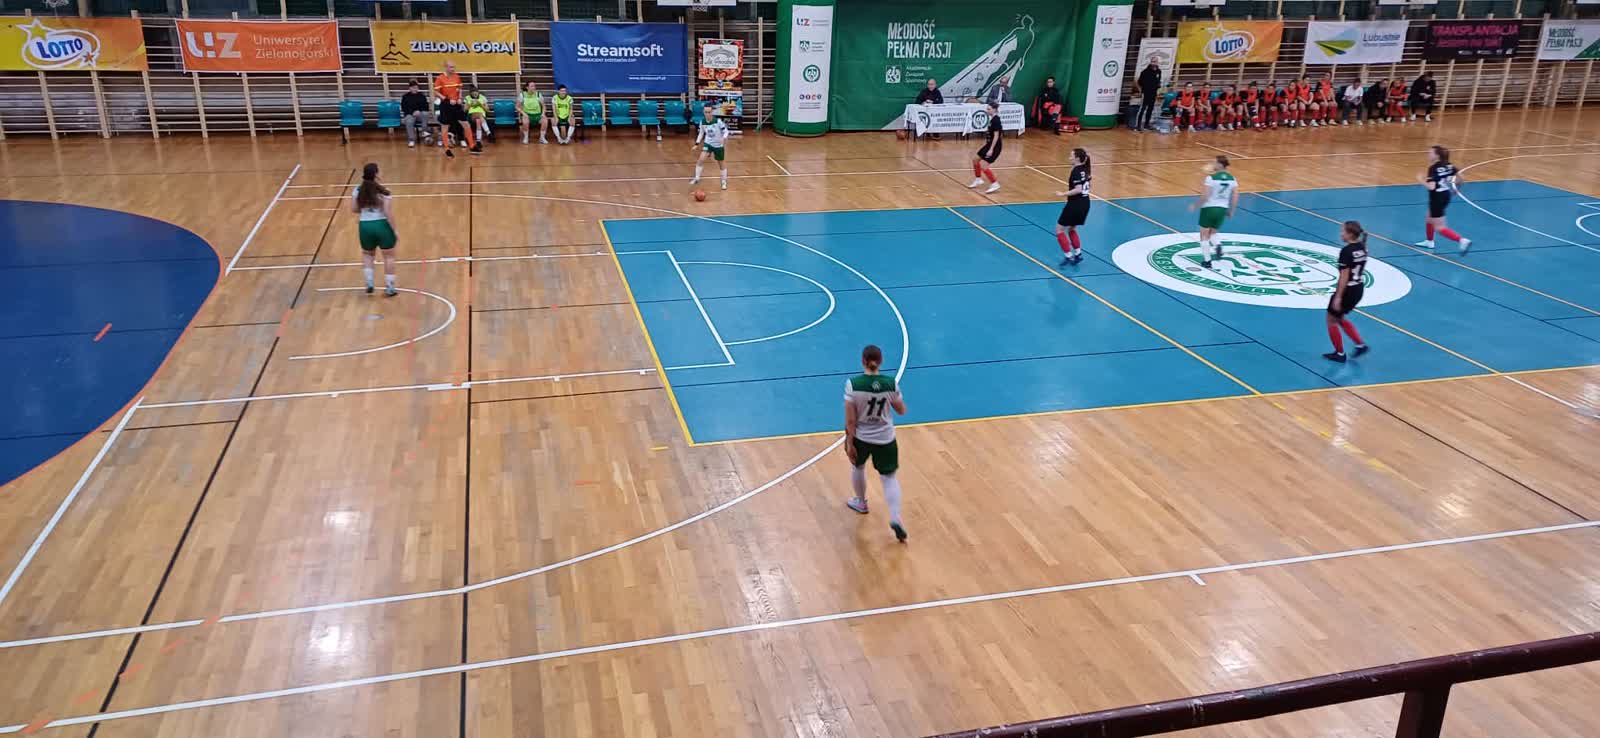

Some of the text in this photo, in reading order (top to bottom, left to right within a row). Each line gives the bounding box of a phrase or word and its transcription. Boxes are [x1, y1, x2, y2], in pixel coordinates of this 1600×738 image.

[887, 19, 936, 40] MŁODOŚĆ
[36, 38, 83, 58] LOTTO
[253, 33, 324, 47] Uniwersytet
[409, 41, 470, 53] ZIELONA
[1215, 37, 1244, 54] LOTTO
[576, 43, 665, 57] Streamsoft
[887, 41, 952, 59] PEŁNA PASJI
[1218, 183, 1230, 194] 7
[866, 397, 887, 417] 11
